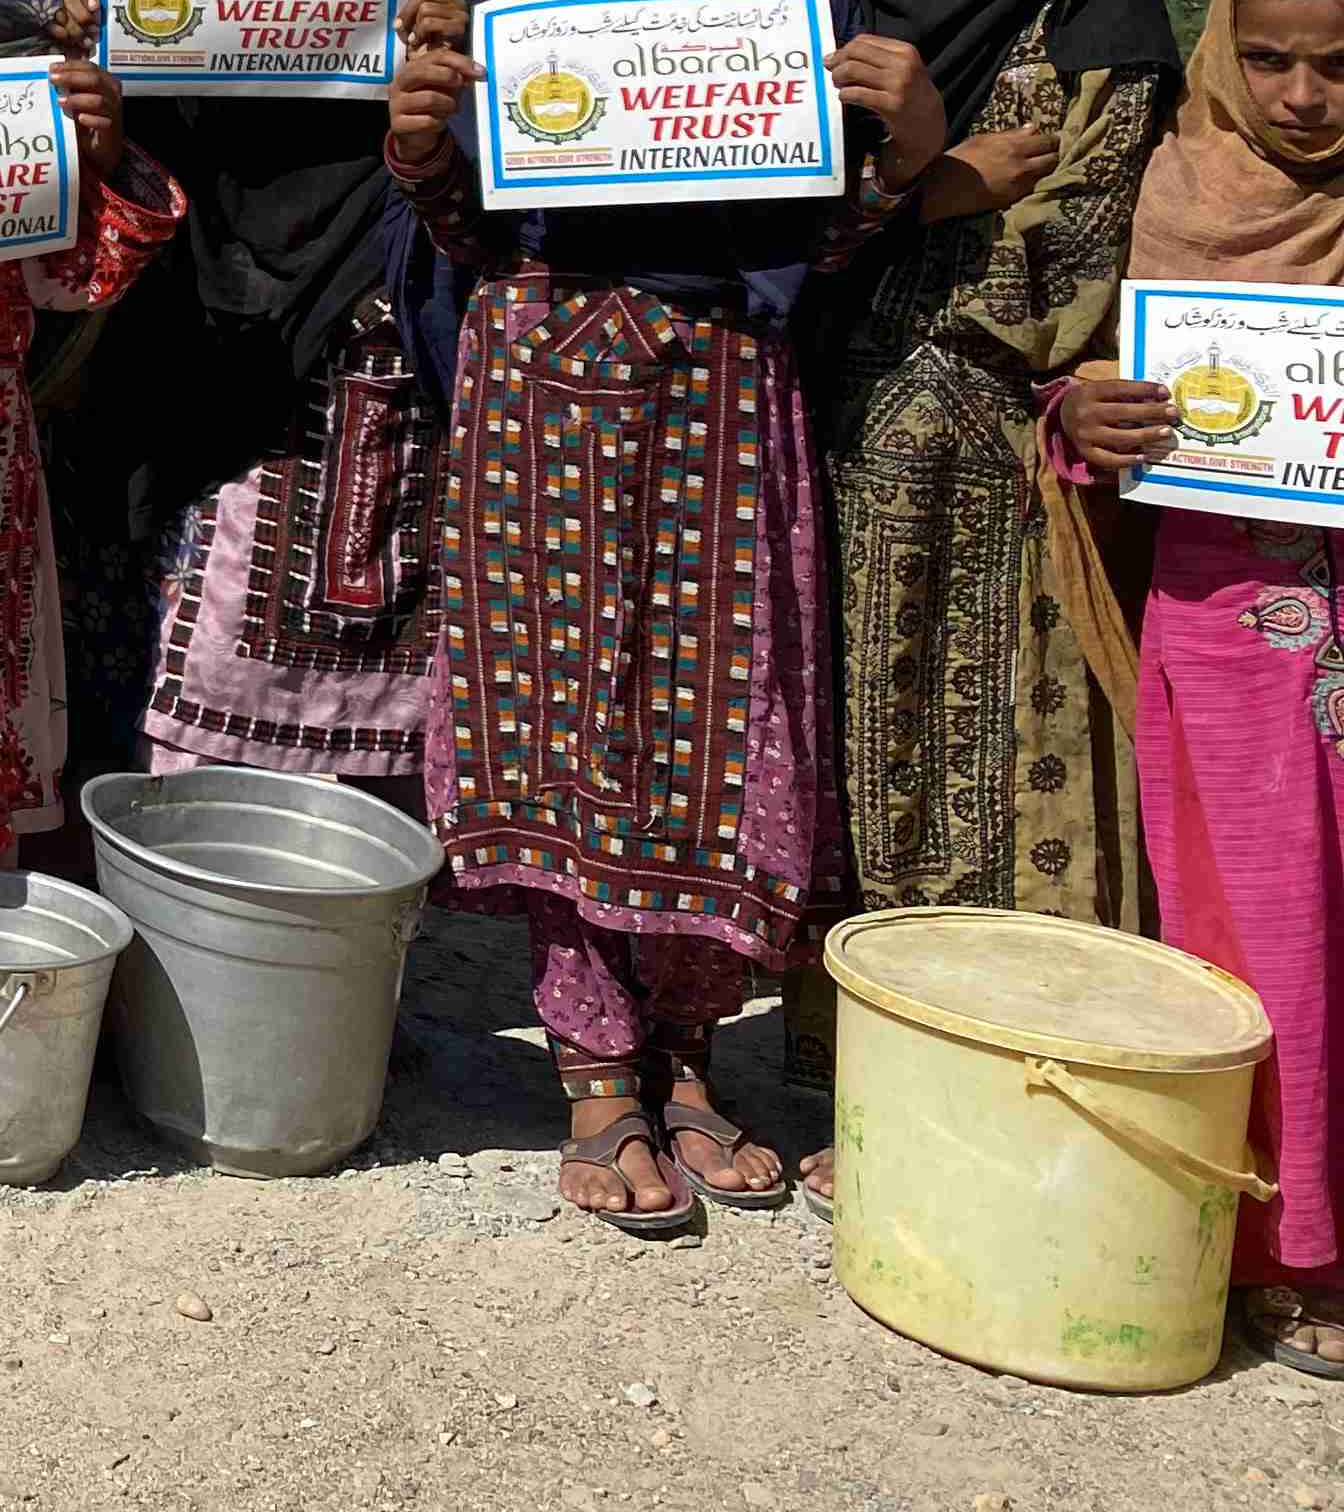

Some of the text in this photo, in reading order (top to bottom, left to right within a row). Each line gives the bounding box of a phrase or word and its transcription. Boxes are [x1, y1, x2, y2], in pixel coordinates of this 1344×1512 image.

[216, 0, 381, 23] WELFARE
[239, 27, 355, 50] TRUST
[210, 52, 383, 73] INTERNATIONAL
[613, 38, 808, 78] albaraka
[619, 80, 807, 111] WELFARE
[649, 112, 782, 142] TRUST
[619, 140, 820, 170] INTERNATIONAL
[1230, 459, 1273, 472] STRENGTH
